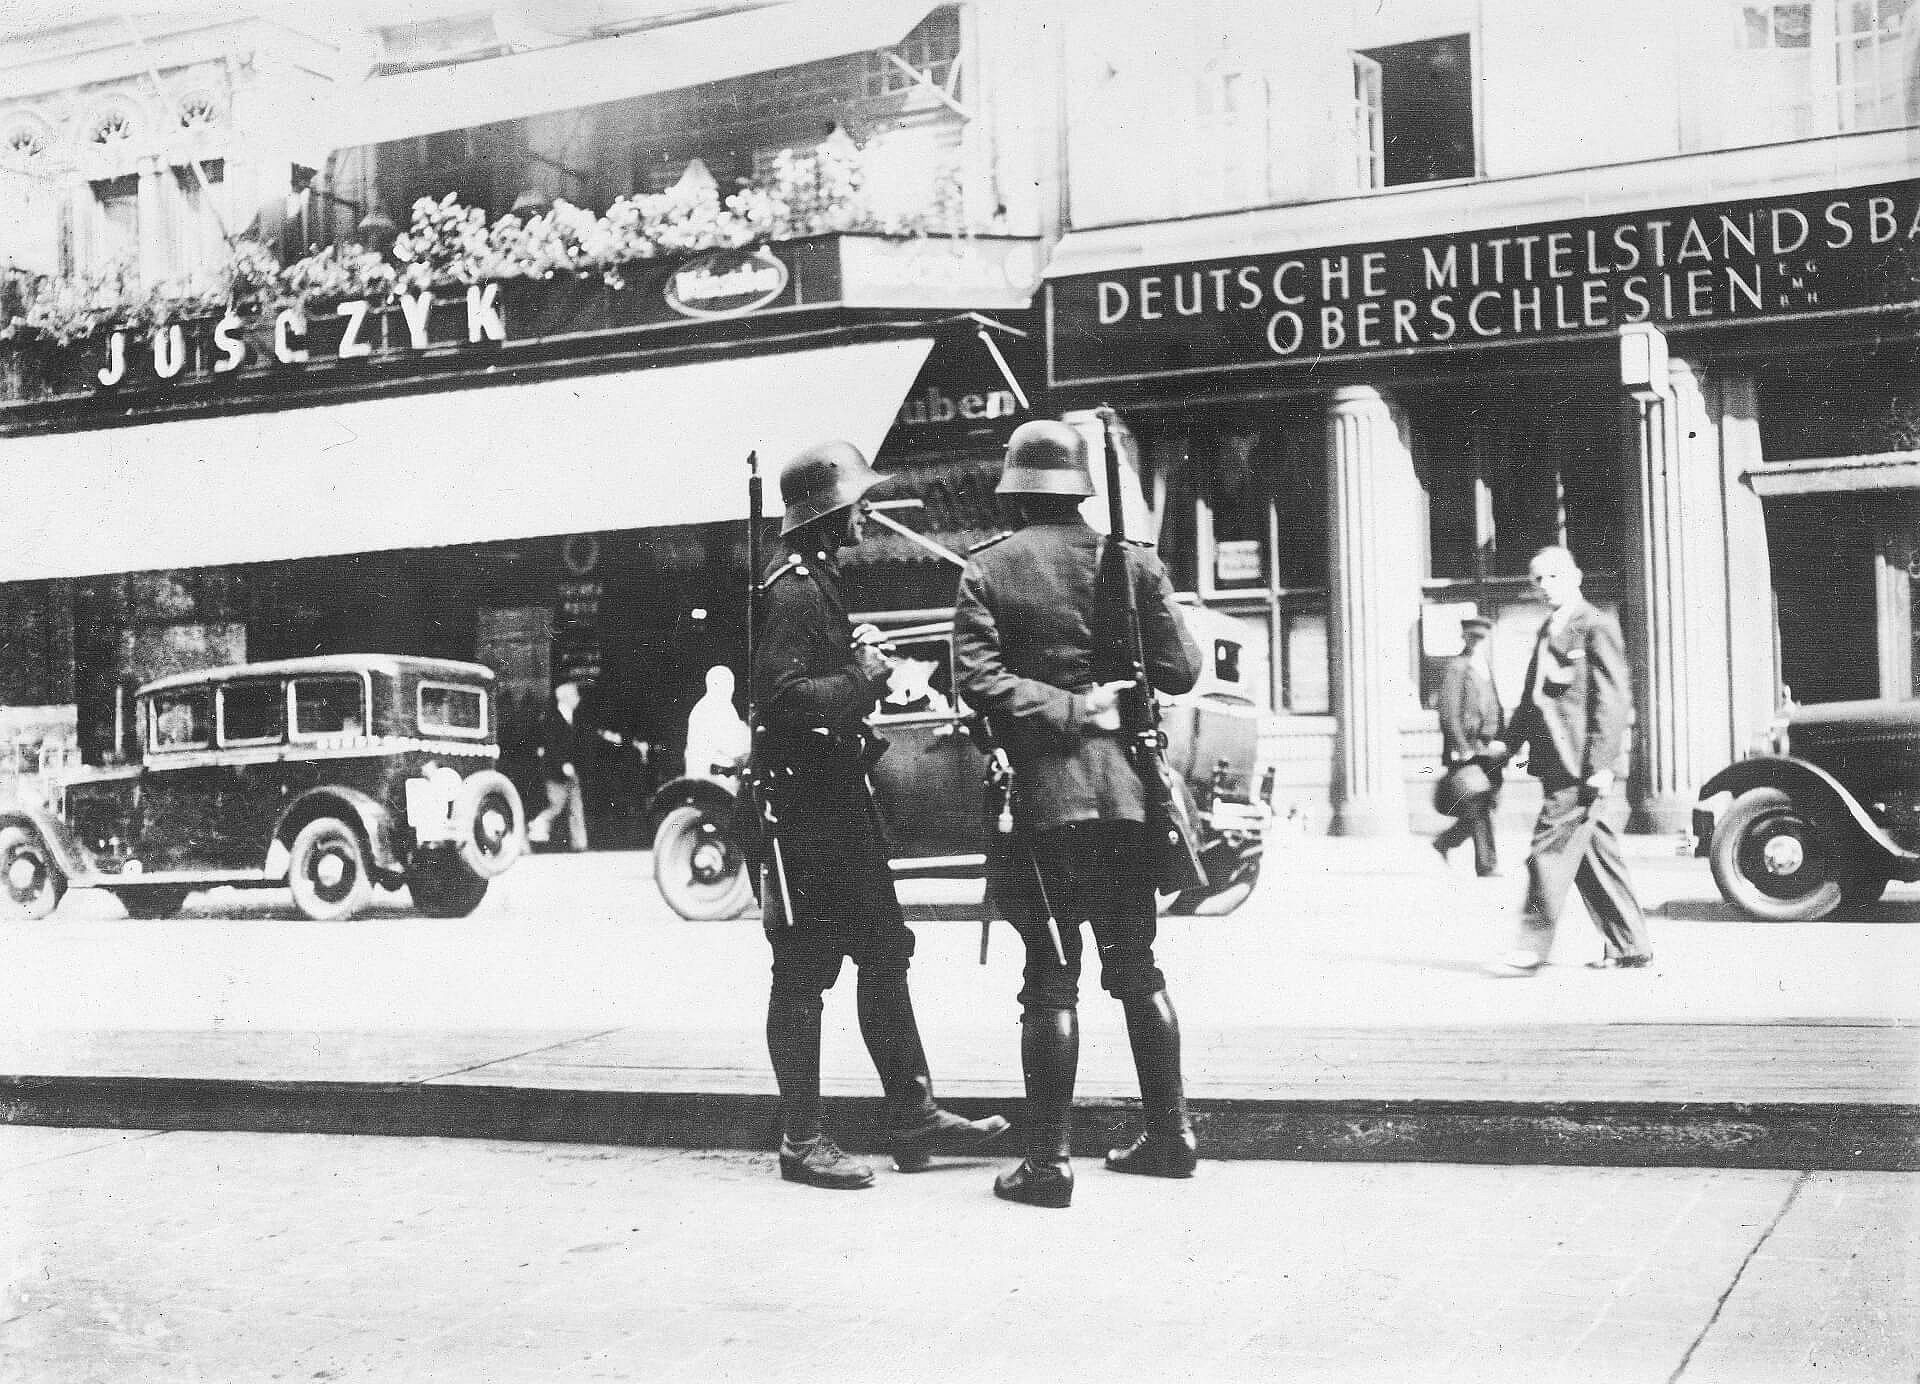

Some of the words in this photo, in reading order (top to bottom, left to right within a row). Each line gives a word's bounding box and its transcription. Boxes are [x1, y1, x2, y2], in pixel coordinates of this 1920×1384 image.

[1099, 251, 1387, 325] DEUTSCHE
[1267, 263, 1763, 355] OBERSCHLESIEN
[97, 283, 506, 386] JUSCZYK
